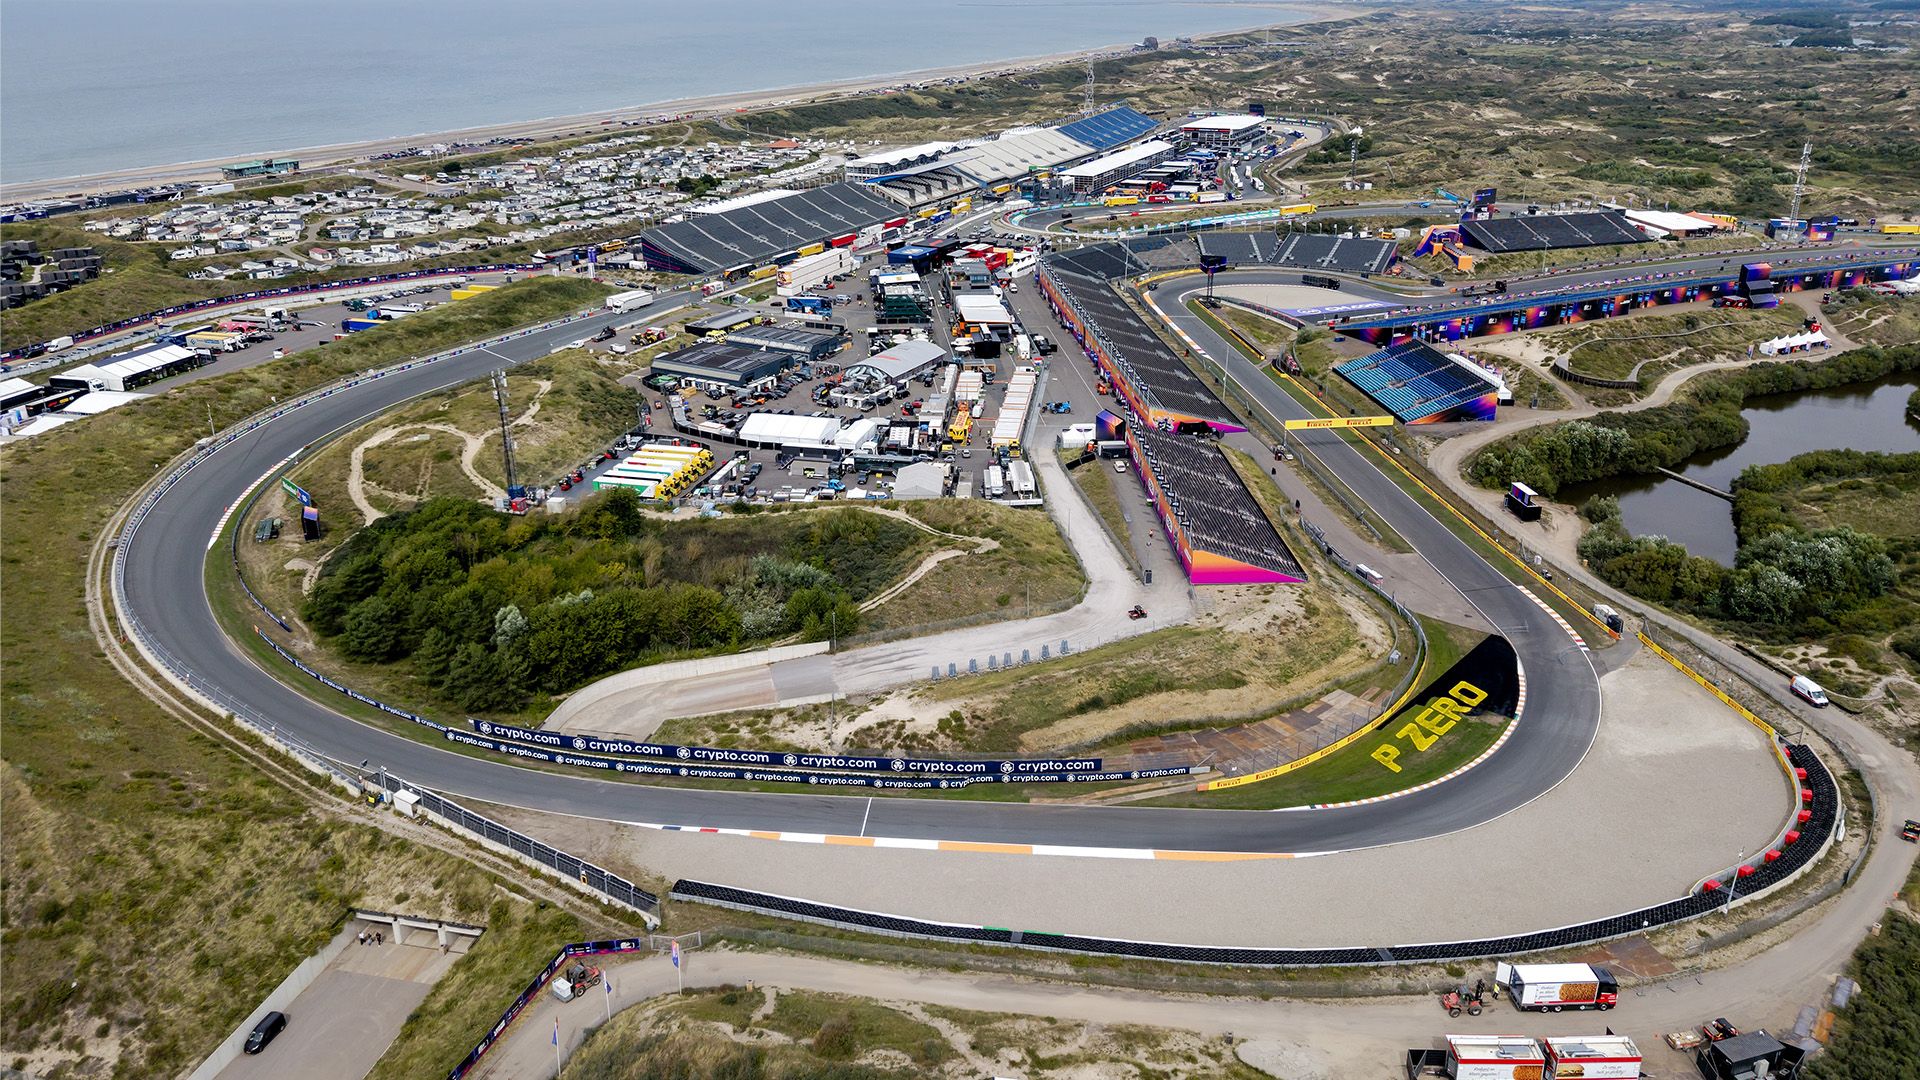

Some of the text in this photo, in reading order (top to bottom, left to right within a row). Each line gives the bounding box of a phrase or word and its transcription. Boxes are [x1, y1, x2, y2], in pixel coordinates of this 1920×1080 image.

[1371, 681, 1488, 773] P ZERO
[494, 725, 560, 745] crypto.com
[455, 735, 494, 749] crypto.com
[589, 740, 663, 755] crypto.com
[508, 746, 549, 760] crypto.com
[694, 749, 769, 763] crypto.com
[565, 757, 608, 769] crypto.com
[801, 756, 877, 768] crypto.com
[909, 761, 986, 772] crypto.com
[1018, 760, 1095, 772] crypto.com
[626, 763, 671, 774] crypto.com
[690, 769, 736, 778] crypto.com
[1141, 767, 1186, 778] crypto.com
[755, 774, 801, 782] crypto.com
[820, 777, 866, 786] crypto.com
[1012, 774, 1059, 783] crypto.com
[1077, 772, 1123, 781] crypto.com
[885, 780, 932, 788] crypto.com
